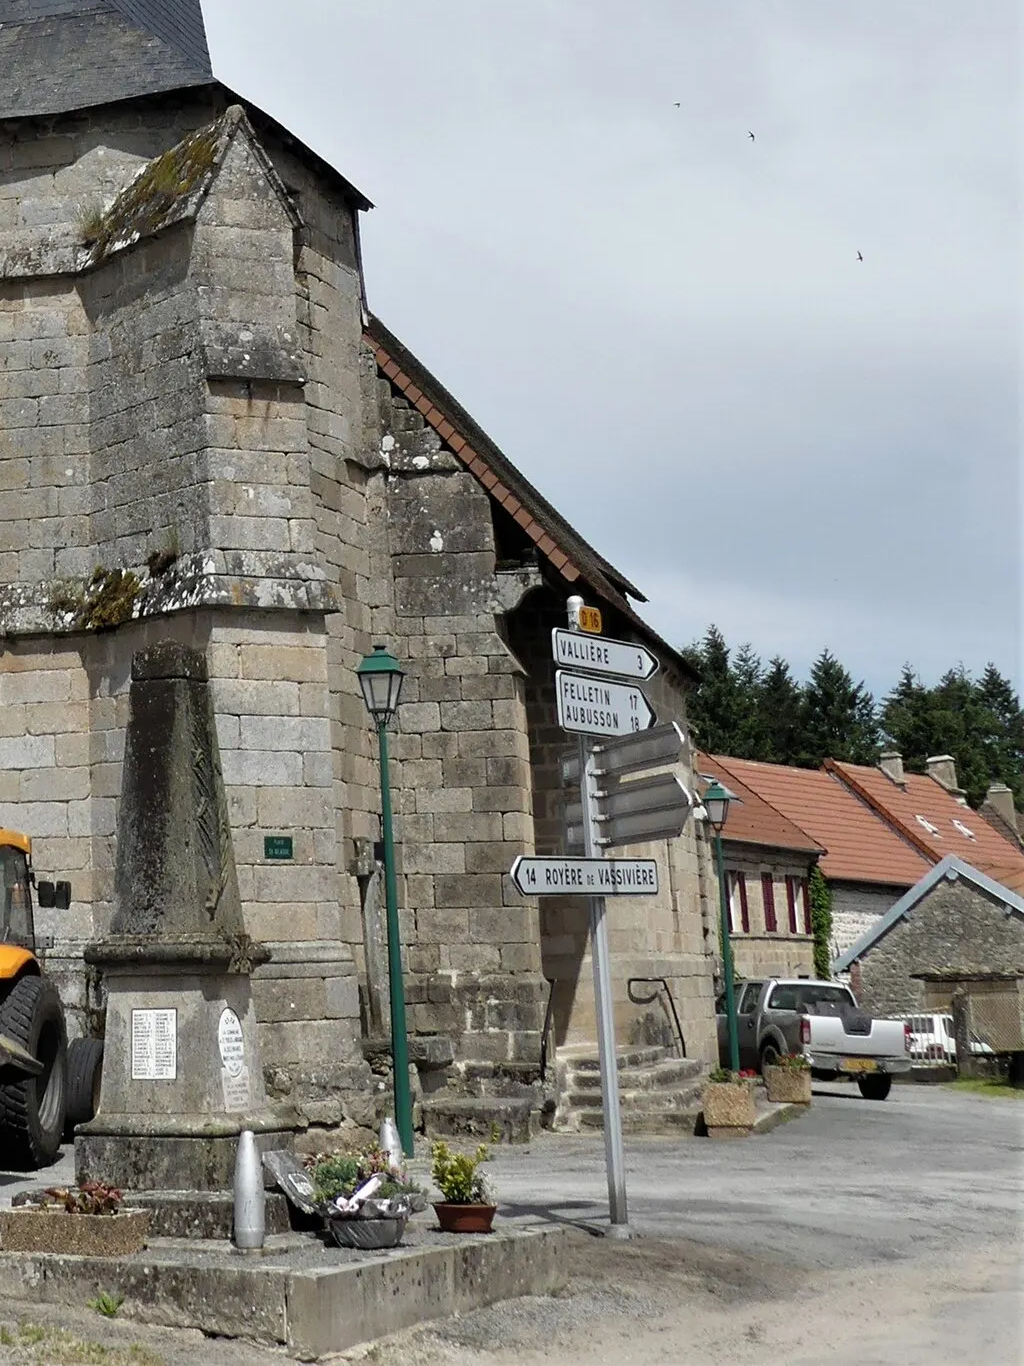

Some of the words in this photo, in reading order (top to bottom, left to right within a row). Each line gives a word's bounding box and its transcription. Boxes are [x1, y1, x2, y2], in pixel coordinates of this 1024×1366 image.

[581, 610, 587, 626] D
[590, 612, 599, 628] 16
[560, 640, 609, 664] VALLIÈRE
[637, 655, 643, 670] 3
[564, 682, 611, 705] FELLETIN
[629, 694, 638, 710] 17
[566, 705, 619, 729] AUBUSSON
[630, 716, 640, 731] 18
[526, 868, 536, 885] 14
[545, 863, 583, 885] ROYÈRE
[598, 864, 655, 885] VASSIVIÈRE
